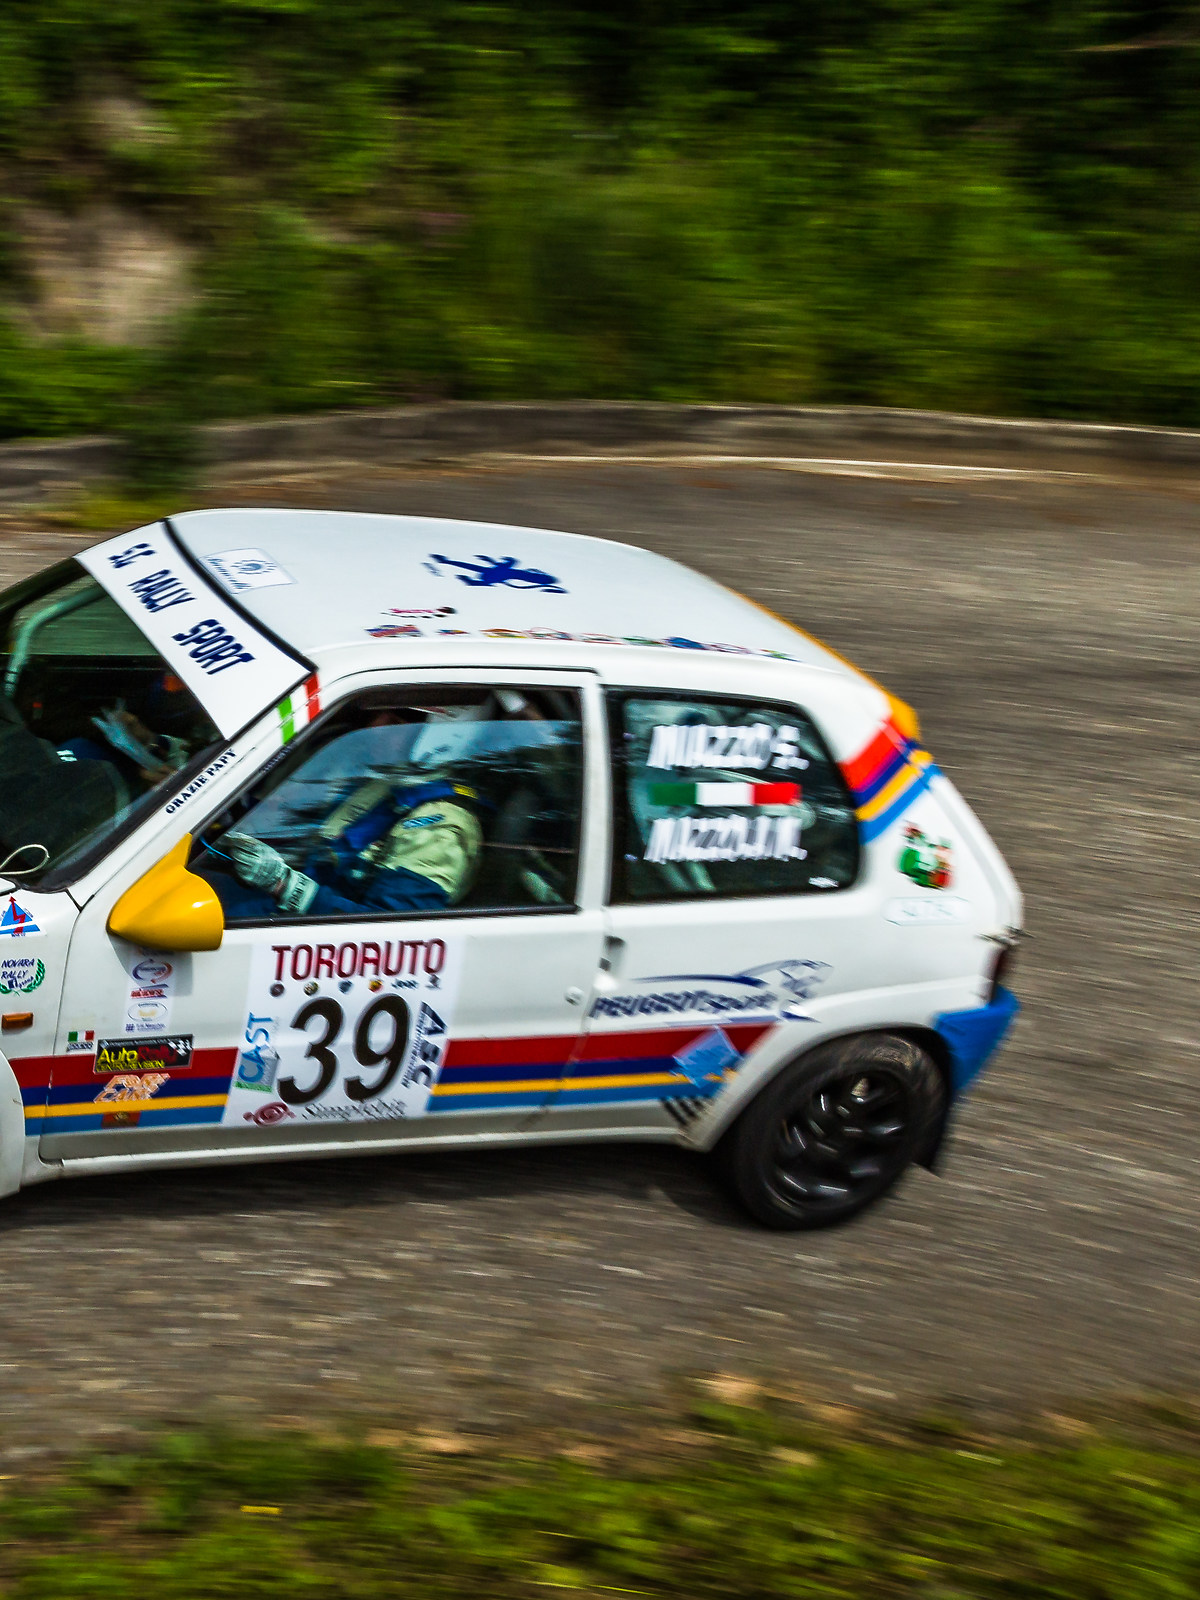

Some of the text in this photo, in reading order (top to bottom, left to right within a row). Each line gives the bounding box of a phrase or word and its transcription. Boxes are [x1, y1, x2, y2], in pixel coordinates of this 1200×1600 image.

[127, 569, 197, 613] RALLY
[171, 619, 256, 675] SPORT
[206, 748, 238, 778] PAPY
[1, 957, 35, 969] NOVARA
[1, 969, 28, 980] RALLY
[272, 938, 447, 982] TOROAUTO
[99, 1047, 138, 1064] Auto
[237, 1012, 274, 1084] CAST
[277, 993, 411, 1105] 39
